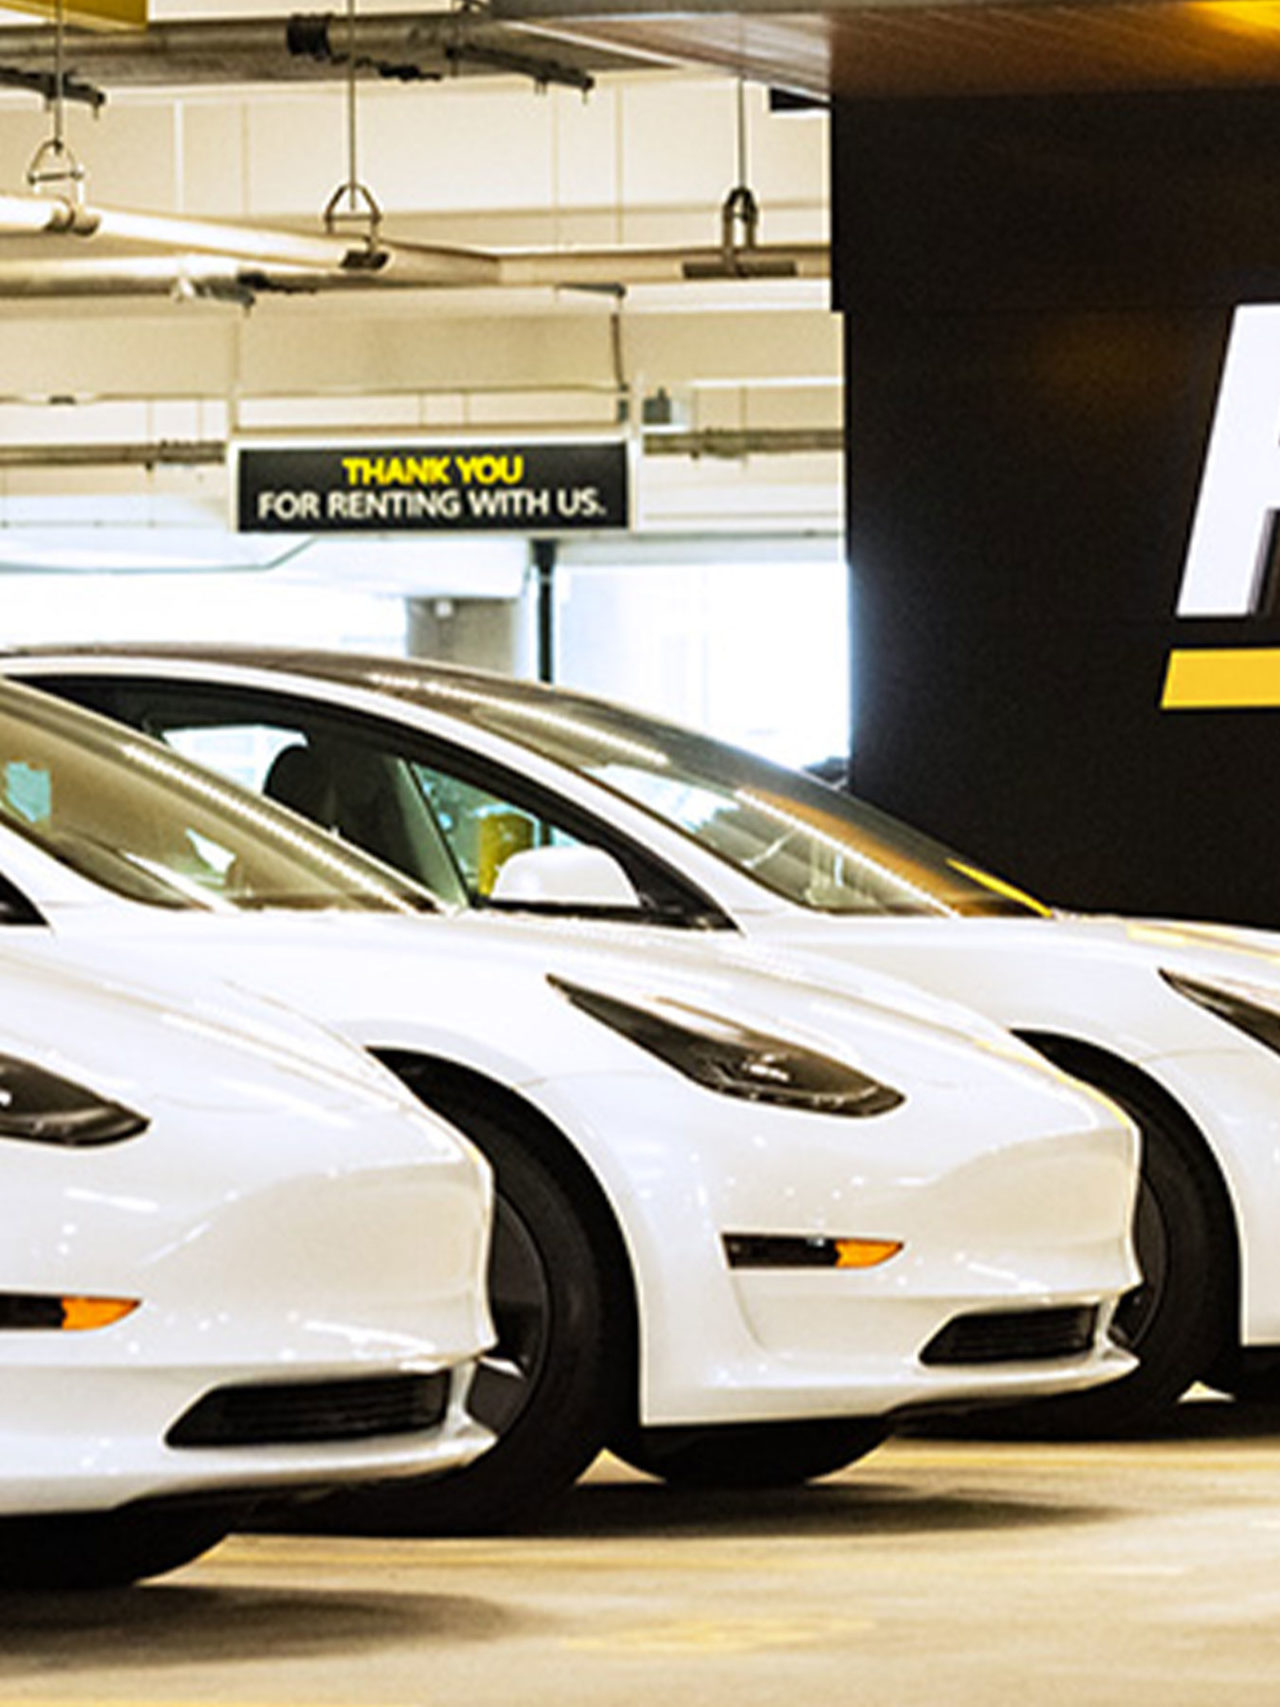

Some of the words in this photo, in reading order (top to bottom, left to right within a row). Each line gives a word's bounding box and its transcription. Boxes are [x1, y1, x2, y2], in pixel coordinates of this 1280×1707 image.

[342, 456, 450, 485] THANK
[457, 455, 524, 484] YOU
[258, 491, 320, 520] FOR
[328, 490, 460, 518] RENTING
[468, 489, 549, 516] WITH
[556, 488, 606, 515] US.
